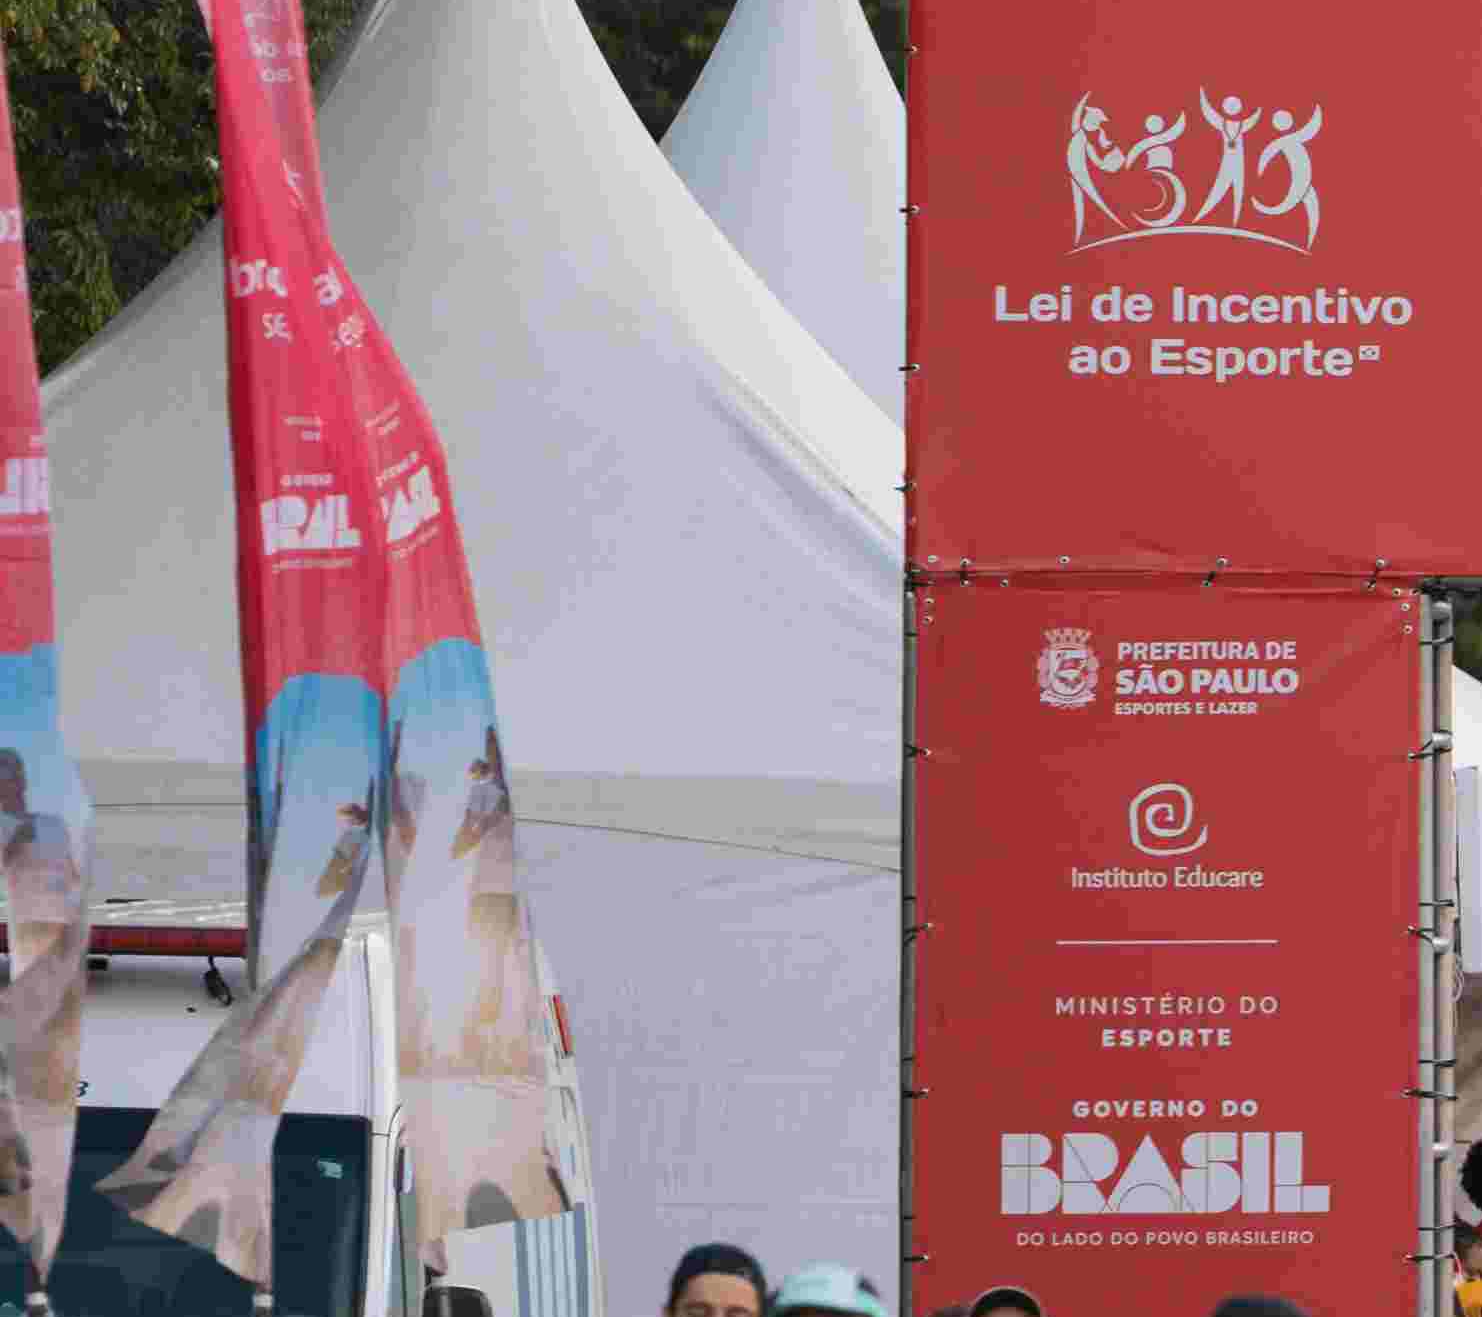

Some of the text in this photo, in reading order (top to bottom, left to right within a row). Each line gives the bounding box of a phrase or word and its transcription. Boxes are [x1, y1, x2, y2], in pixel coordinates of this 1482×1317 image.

[995, 284, 1413, 326] Lei de Incentivo
[1068, 338, 1354, 383] ao Esporte
[1117, 640, 1297, 661] PREFEITURA DE
[1115, 663, 1299, 695] SÃO PAULO
[1114, 701, 1259, 716] ESPORTES E LAZER
[1071, 863, 1264, 889] Instituto Educare
[1055, 992, 1278, 1016] MINISTÉRIO DO
[1102, 1028, 1232, 1048] ESPORTE
[1072, 1098, 1259, 1118] GOVERNO DO
[1001, 1130, 1331, 1215] BRASIL
[1016, 1230, 1315, 1246] DO LADO DO POVO BRASILEIRO
